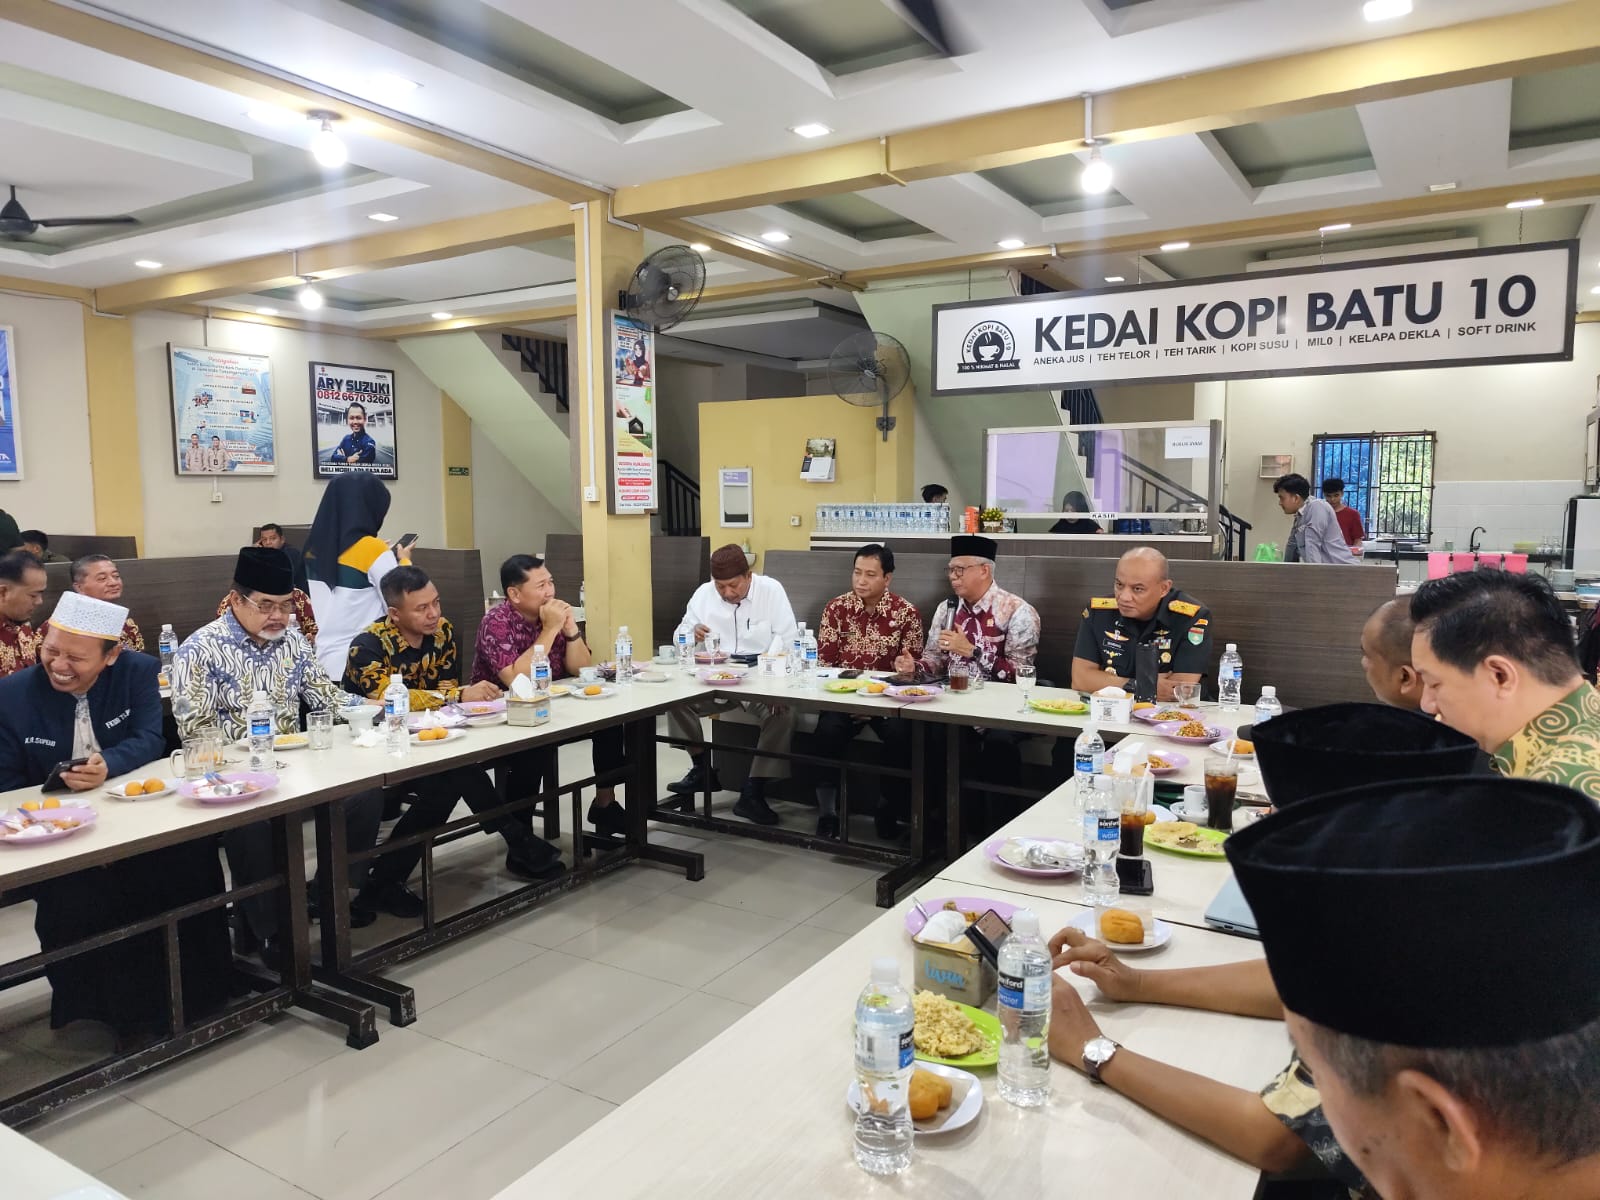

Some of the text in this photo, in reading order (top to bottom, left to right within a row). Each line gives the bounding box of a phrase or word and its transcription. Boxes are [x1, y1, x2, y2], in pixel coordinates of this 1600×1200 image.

[1035, 274, 1536, 352] KEDAI KOPI BATU 10
[966, 331, 978, 353] KEDAI
[977, 324, 993, 333] KOPI
[995, 325, 1010, 341] BATU
[1033, 356, 1065, 366] ANEKA
[1067, 355, 1085, 364] JUS
[1098, 352, 1116, 362] TEH
[1118, 350, 1151, 361] TELOR
[1164, 347, 1184, 358] TEH
[1186, 345, 1217, 356] TARIK
[1231, 342, 1257, 353] KOPI
[1259, 339, 1289, 351] SUSU
[1349, 332, 1396, 344] KELAPA
[1399, 328, 1441, 341] DEKLA
[1458, 324, 1492, 337] SOFT
[1495, 321, 1537, 334] DRINK
[317, 376, 390, 396] ARY SUZUKI
[317, 390, 390, 405] 0812 6670 3260
